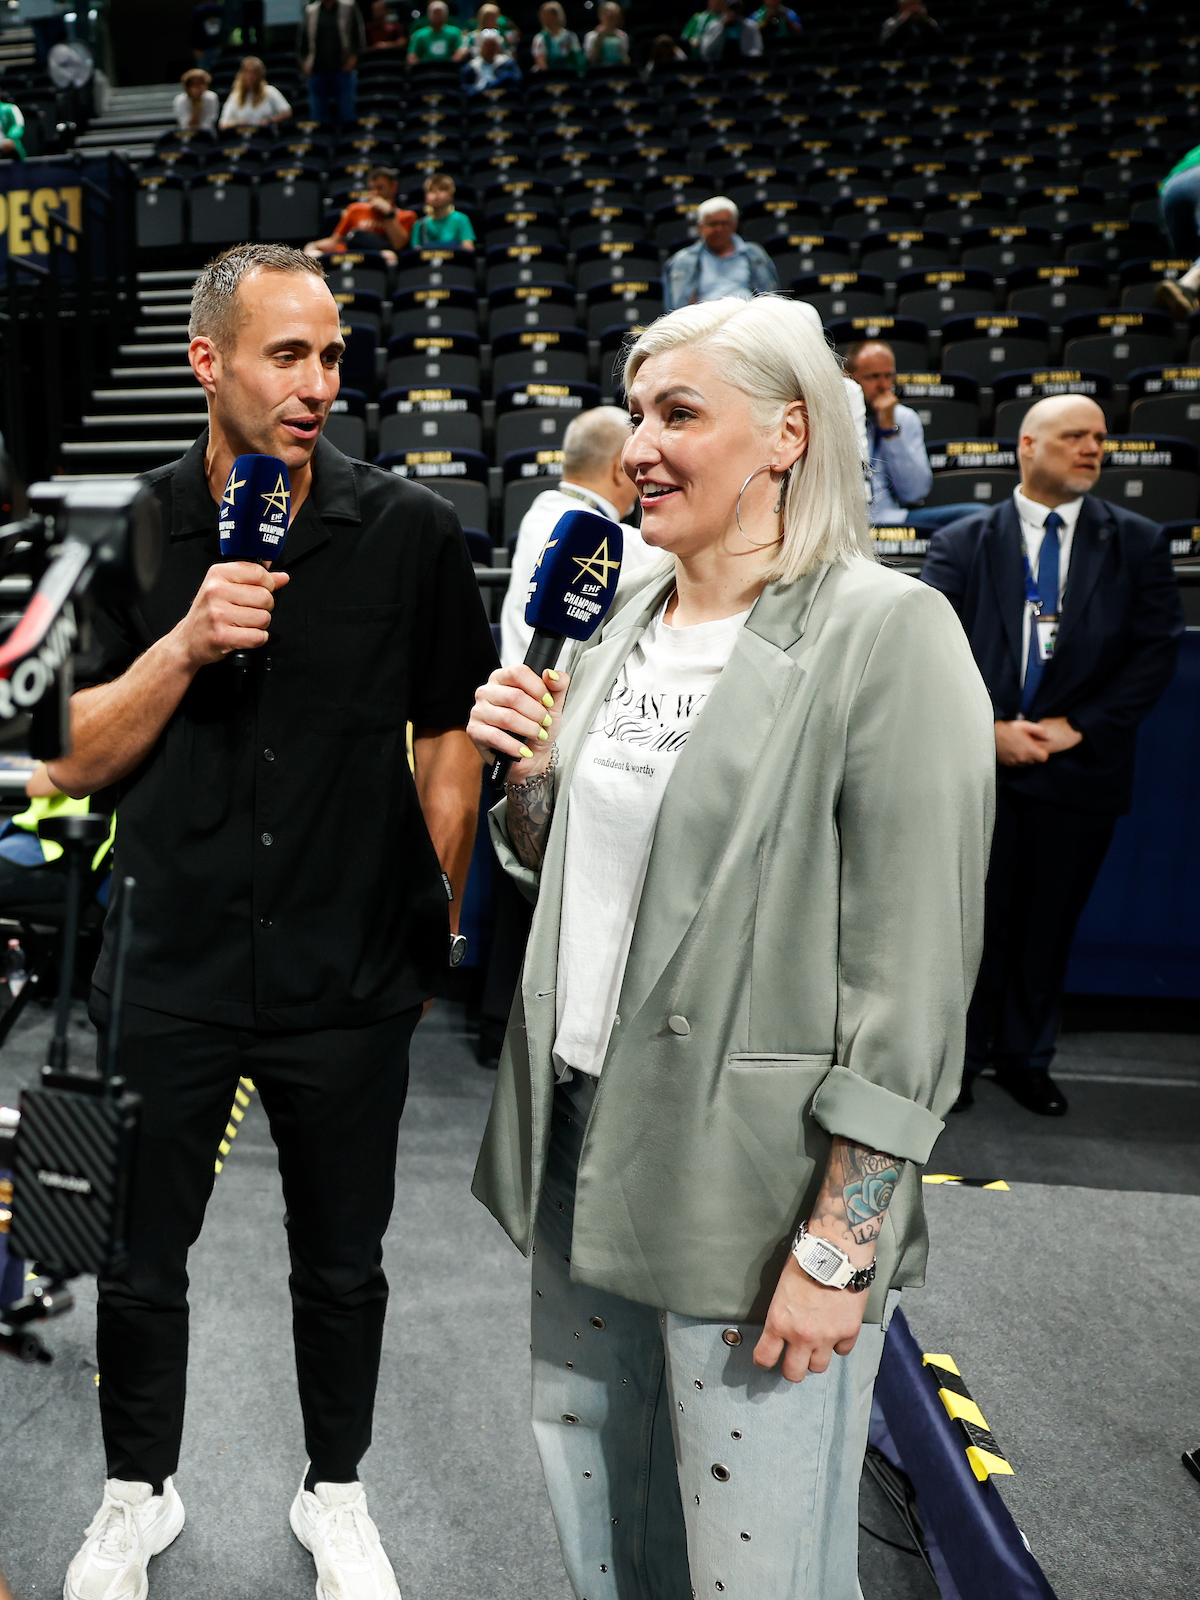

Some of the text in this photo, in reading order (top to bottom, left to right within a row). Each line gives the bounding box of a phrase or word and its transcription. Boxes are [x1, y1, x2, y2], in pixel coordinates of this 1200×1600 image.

[581, 583, 602, 593] EHF
[563, 591, 602, 615] CHAMPIONS
[566, 605, 592, 623] LEAGUE
[592, 757, 625, 771] confident
[631, 764, 656, 778] worthy
